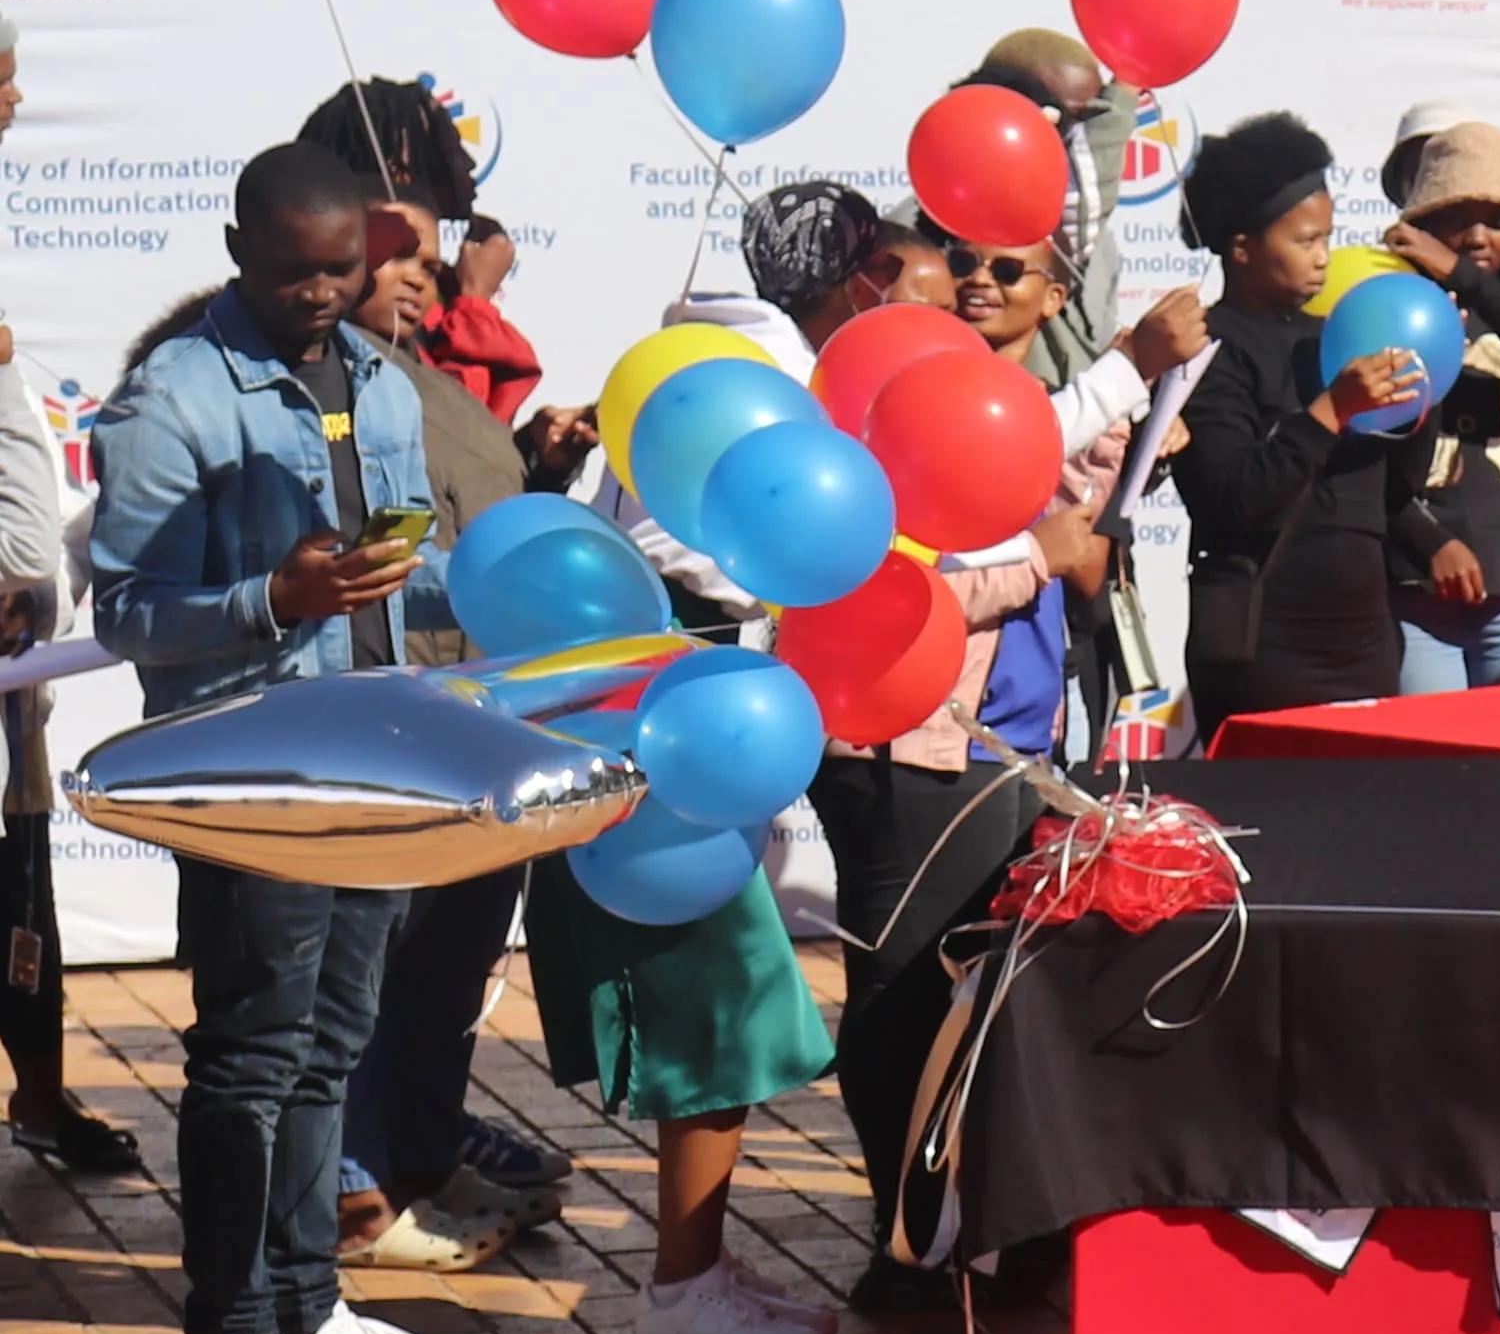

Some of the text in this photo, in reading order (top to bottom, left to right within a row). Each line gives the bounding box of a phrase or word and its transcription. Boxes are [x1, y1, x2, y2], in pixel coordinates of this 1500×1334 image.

[41, 158, 68, 180] of
[81, 155, 246, 181] Information
[738, 166, 763, 186] of
[7, 191, 230, 215] Communication
[647, 198, 695, 219] and
[9, 225, 169, 252] Technology
